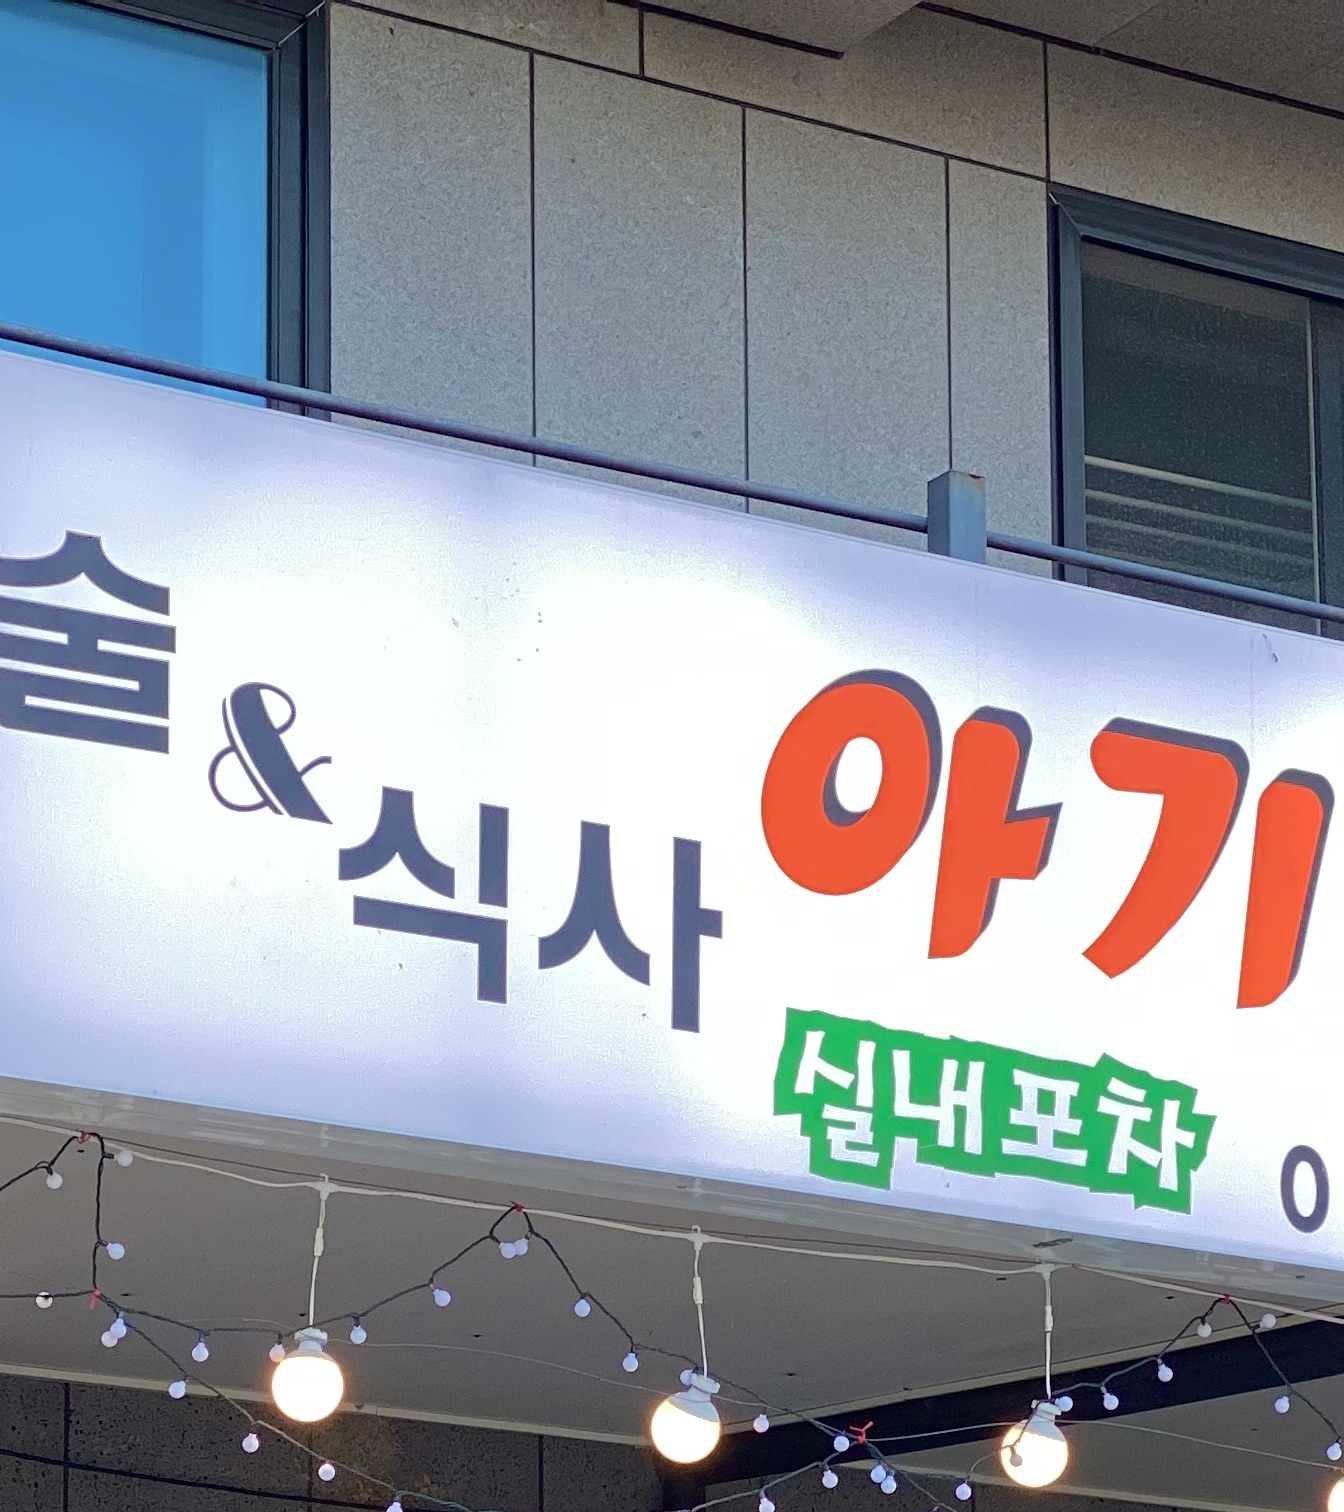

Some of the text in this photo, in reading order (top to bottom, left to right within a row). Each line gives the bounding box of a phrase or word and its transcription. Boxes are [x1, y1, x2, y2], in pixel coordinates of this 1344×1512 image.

[208, 681, 333, 825] &
[338, 786, 723, 1034] 식사
[761, 669, 1334, 1010] 아기
[793, 1024, 1199, 1193] 실내포차
